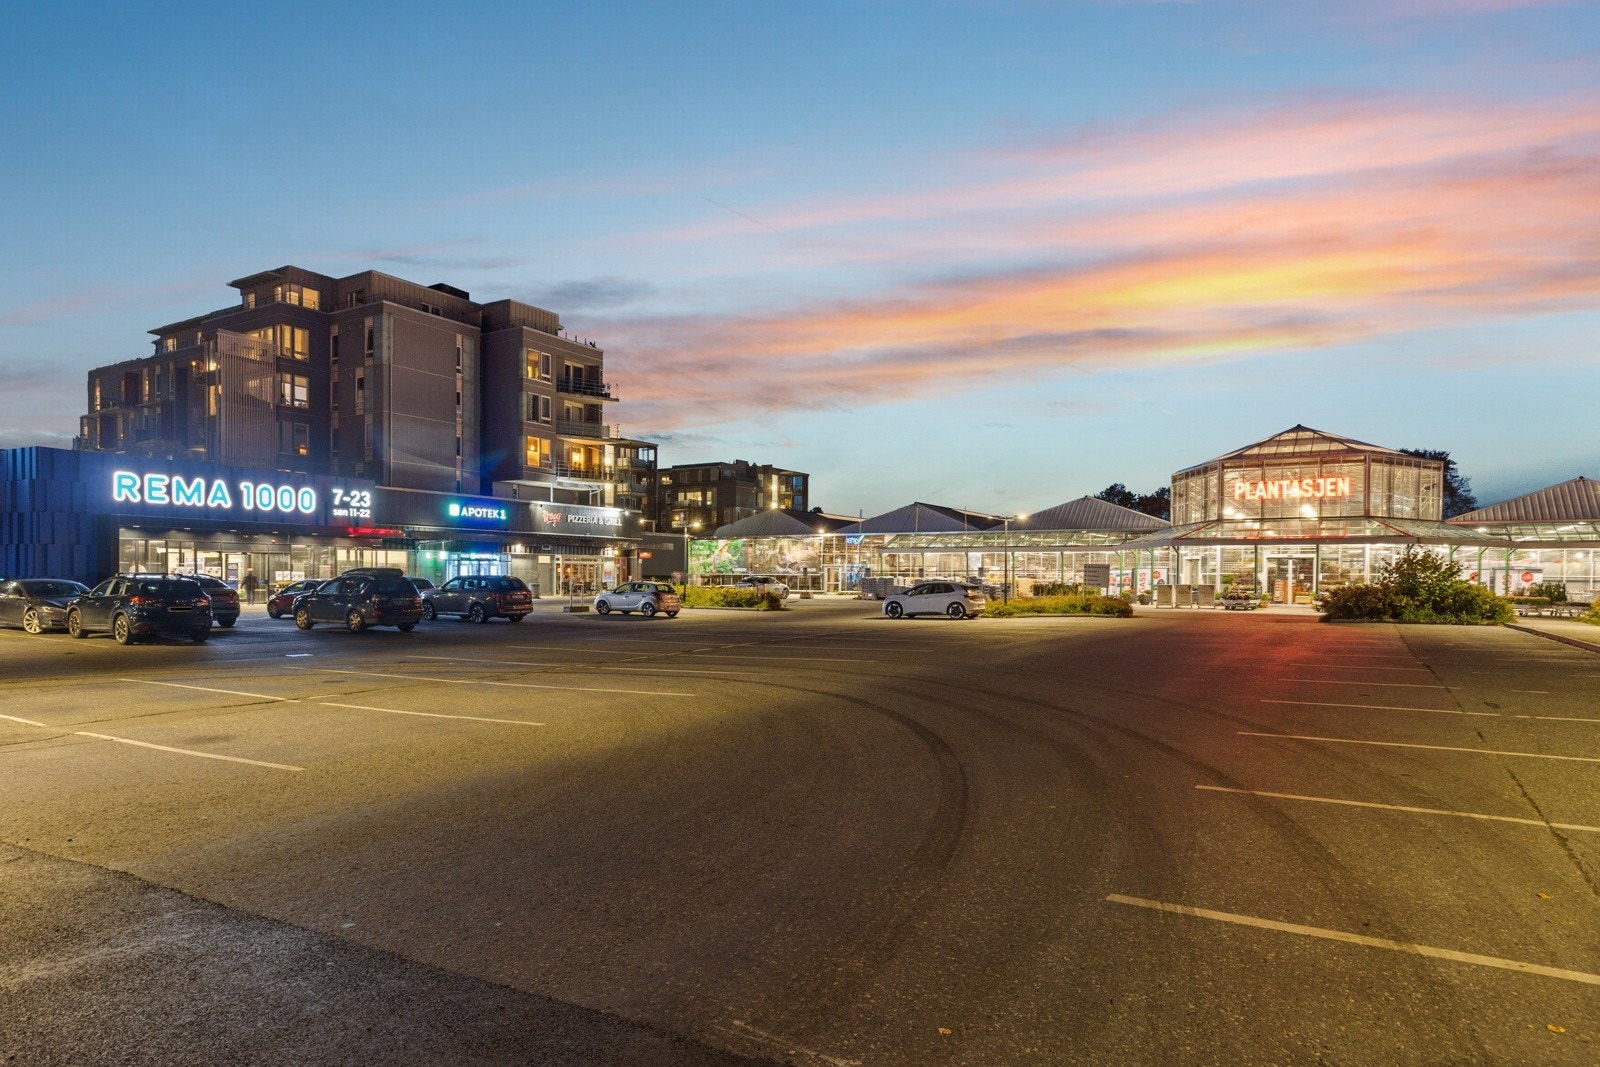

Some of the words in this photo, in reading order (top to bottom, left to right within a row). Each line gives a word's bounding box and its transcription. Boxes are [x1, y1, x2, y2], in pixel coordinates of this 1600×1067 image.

[113, 471, 232, 508] REMA
[239, 481, 316, 513] 1000
[332, 488, 371, 508] 7-23
[1234, 477, 1350, 500] PLANTASJEN
[567, 514, 598, 525] PIZZERIA
